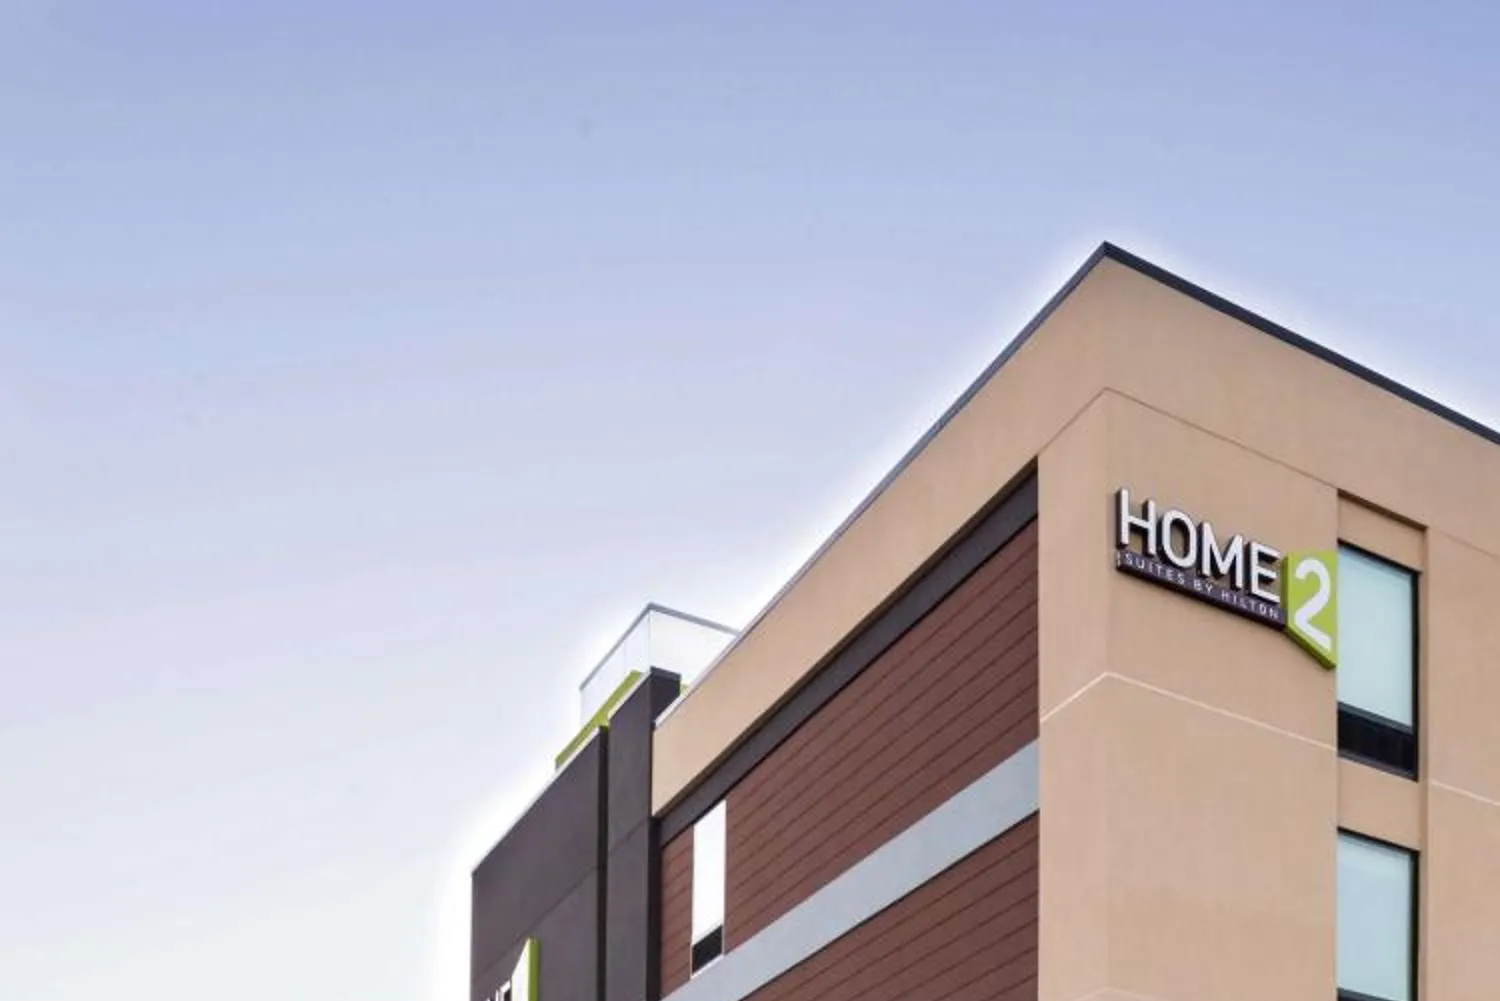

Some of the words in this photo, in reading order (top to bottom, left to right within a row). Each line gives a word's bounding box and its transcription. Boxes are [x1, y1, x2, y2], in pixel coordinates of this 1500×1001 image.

[1116, 488, 1281, 604] HOME
[1294, 557, 1332, 653] 2
[1125, 552, 1186, 586] SUITES
[1193, 577, 1214, 593] BY
[1221, 589, 1280, 620] HILTON
